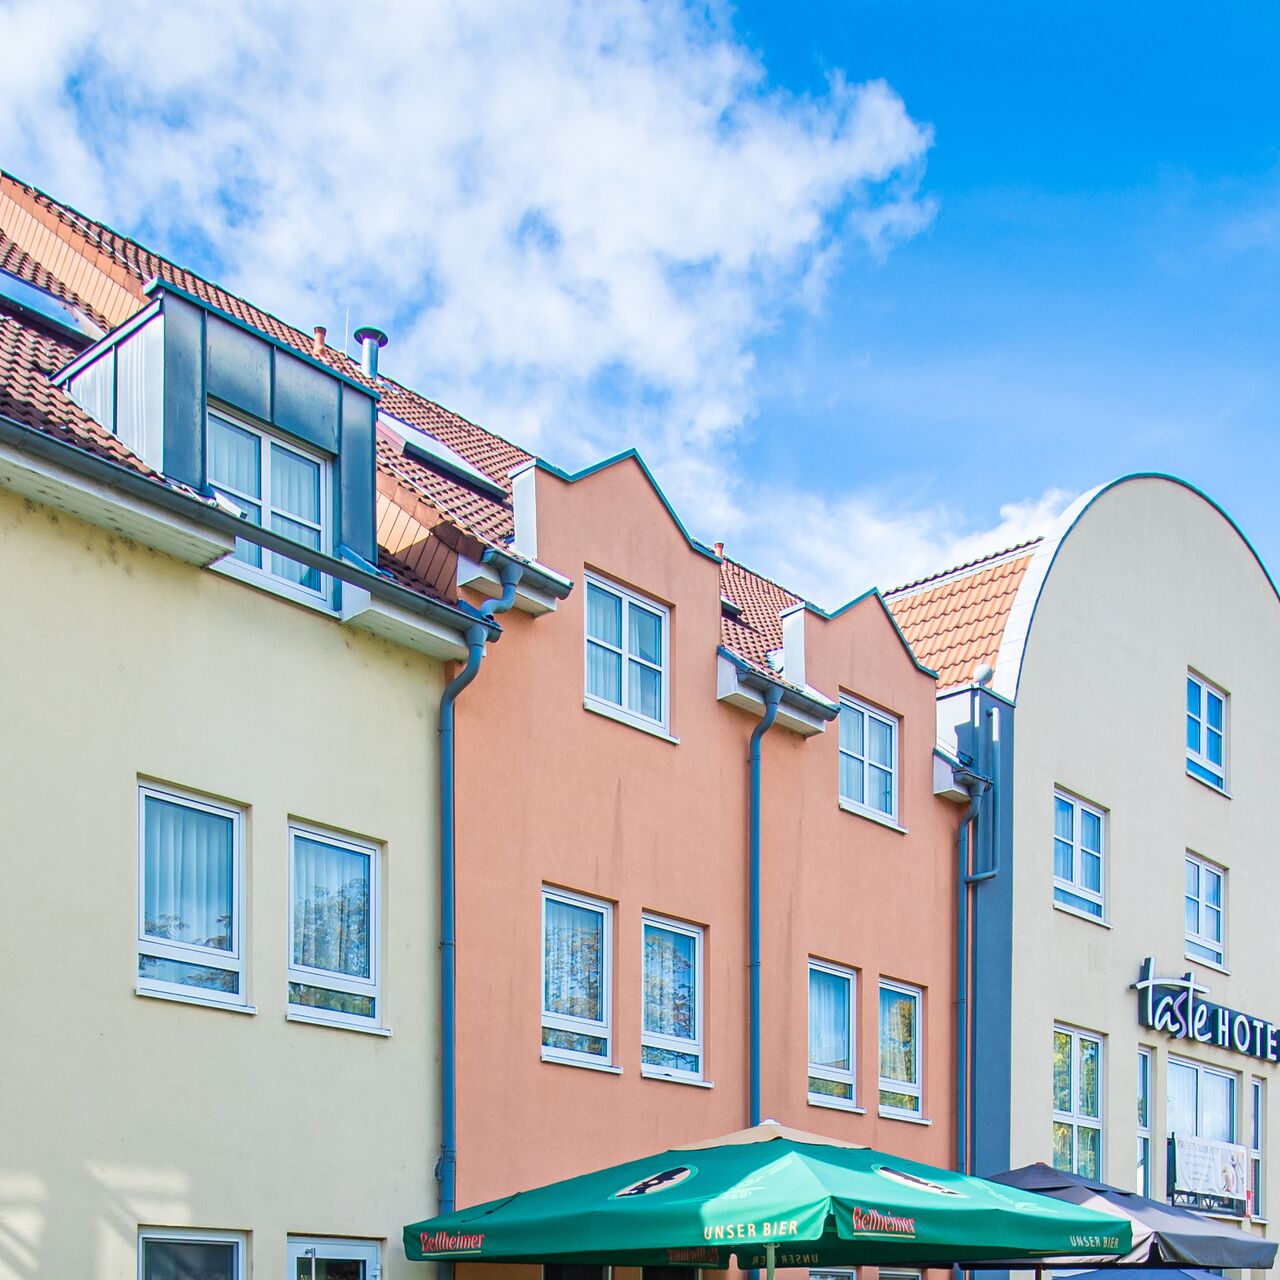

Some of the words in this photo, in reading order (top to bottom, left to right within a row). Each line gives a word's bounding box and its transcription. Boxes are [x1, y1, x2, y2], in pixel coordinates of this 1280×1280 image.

[1133, 955, 1210, 1042] taste
[703, 1223, 757, 1241] UNSER
[763, 1220, 798, 1236] BIER
[852, 1207, 916, 1234] Bellheimer
[420, 1231, 485, 1251] Bellheimer
[1069, 1235, 1101, 1247] UNSER
[1103, 1236, 1119, 1248] BIER
